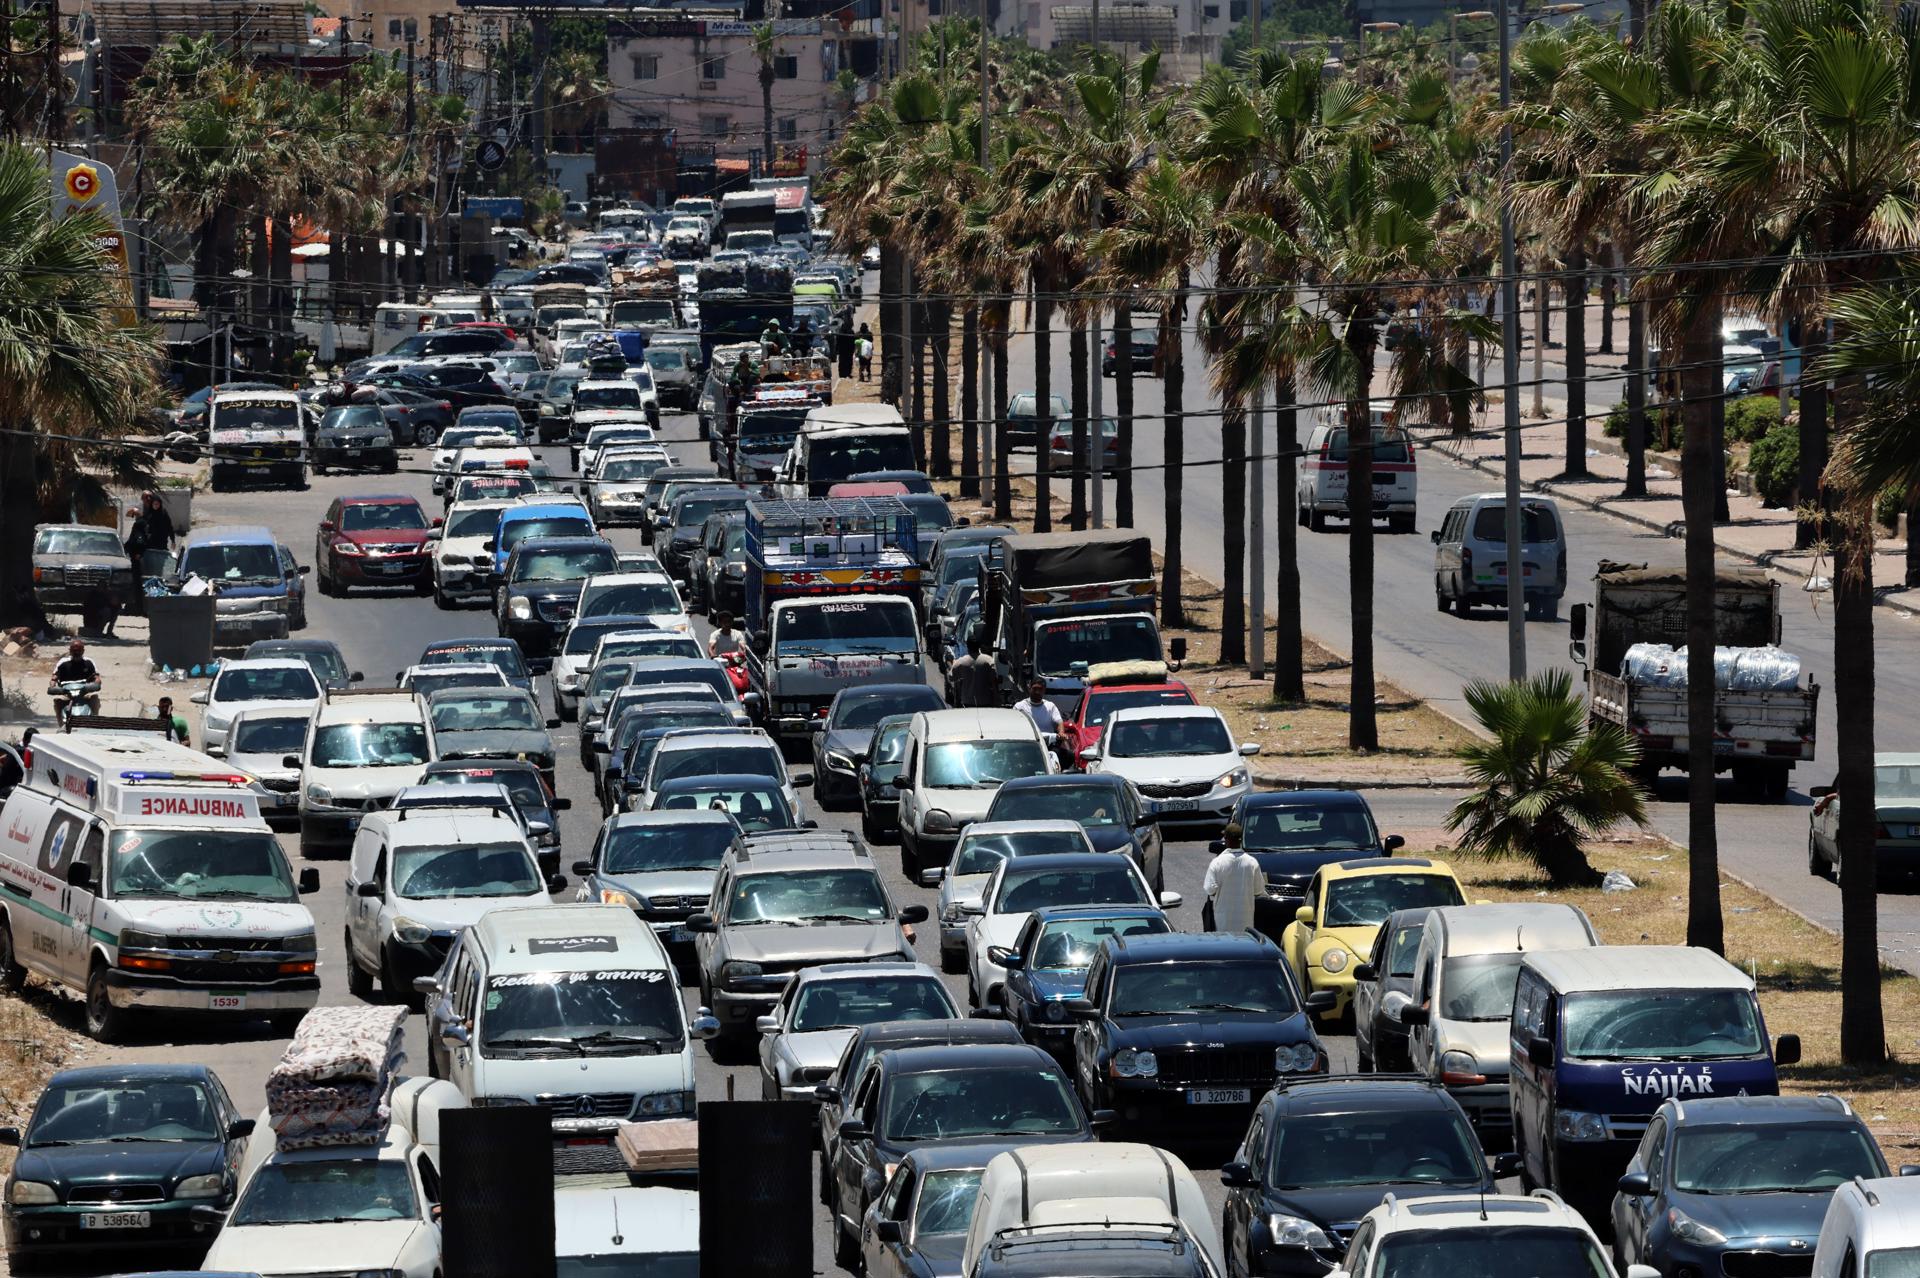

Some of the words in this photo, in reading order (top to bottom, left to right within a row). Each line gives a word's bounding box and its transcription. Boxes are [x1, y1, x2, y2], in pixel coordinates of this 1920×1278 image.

[538, 937, 609, 945] ISTANA
[569, 972, 589, 984] ya
[595, 970, 665, 983] ommy
[213, 998, 239, 1007] 1539
[1621, 1066, 1712, 1076] CAFE
[1623, 1074, 1715, 1099] NAJJAR
[1207, 1090, 1244, 1103] 320786
[88, 1215, 96, 1227] B
[103, 1213, 142, 1227] 538564
